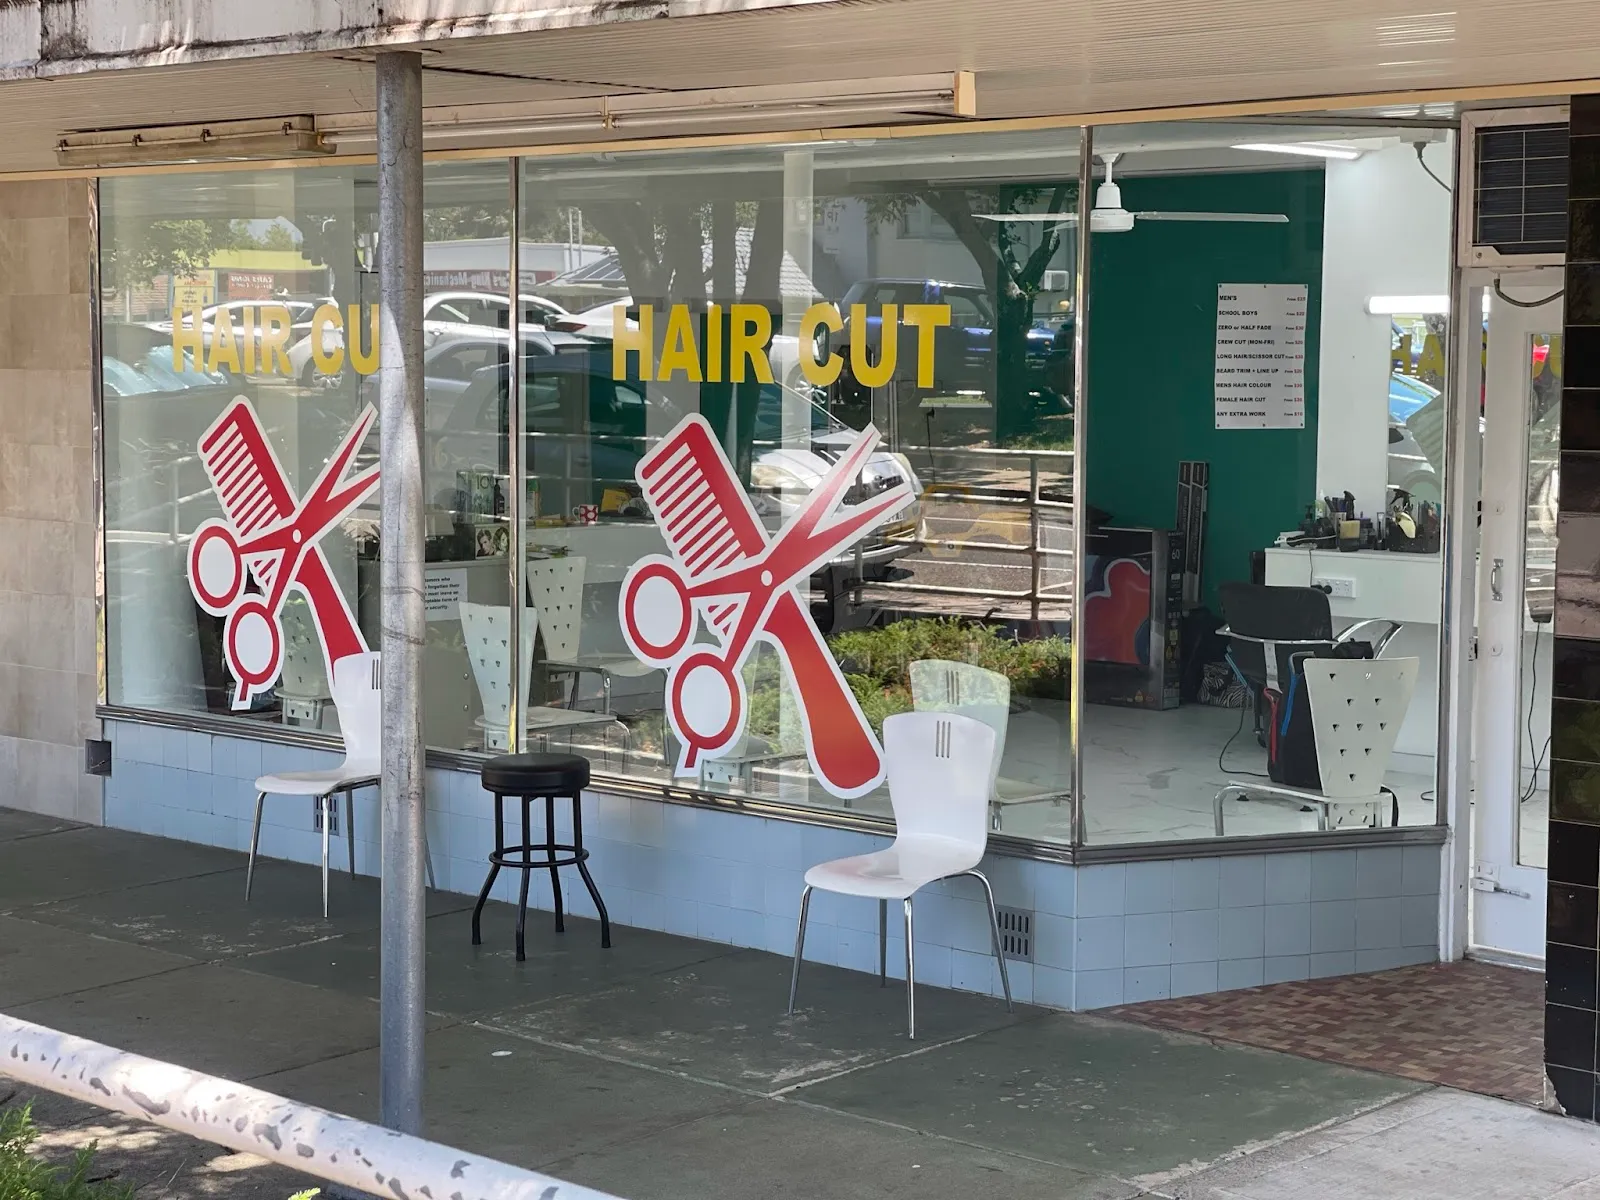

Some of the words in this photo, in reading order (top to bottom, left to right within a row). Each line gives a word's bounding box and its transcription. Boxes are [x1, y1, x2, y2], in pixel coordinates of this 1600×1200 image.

[172, 306, 293, 376] HAIR
[312, 304, 380, 376] CU
[613, 303, 774, 384] HAIR
[798, 302, 952, 389] CUT
